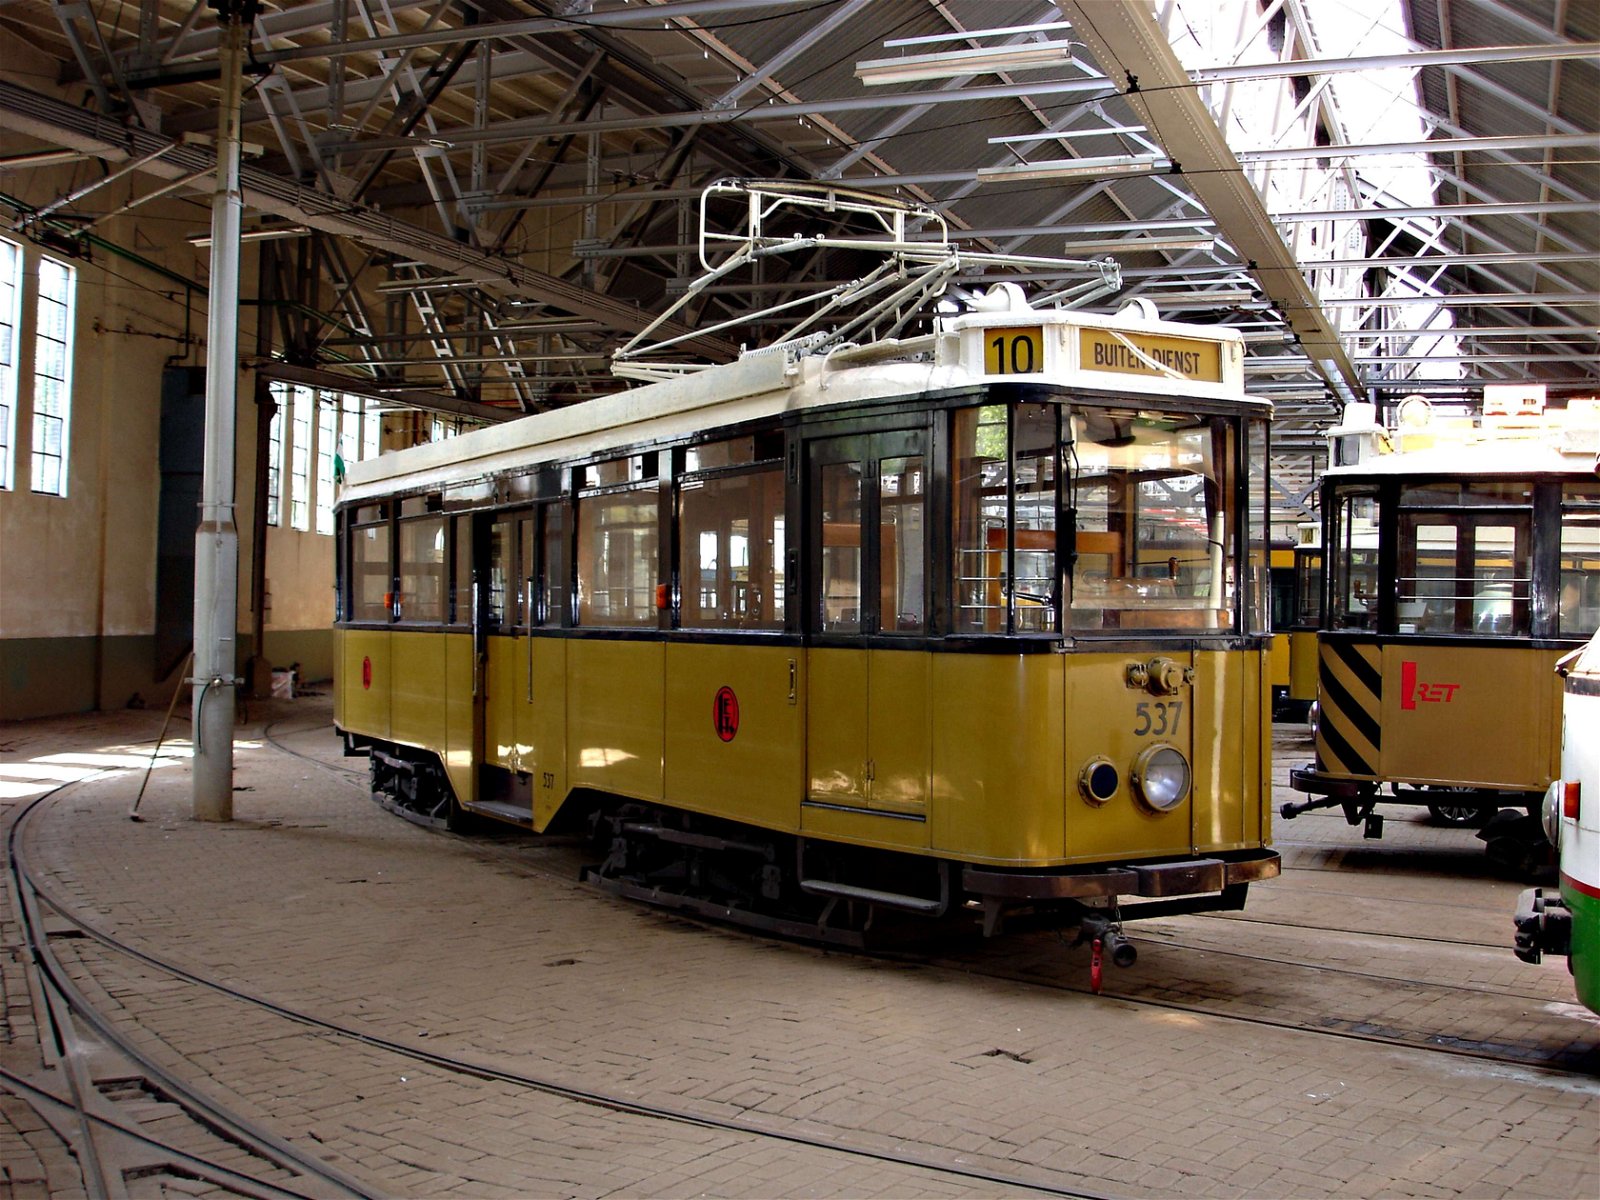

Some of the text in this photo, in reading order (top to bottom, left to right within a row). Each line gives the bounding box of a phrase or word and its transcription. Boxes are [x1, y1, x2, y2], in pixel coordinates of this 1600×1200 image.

[992, 334, 1034, 374] 10
[1417, 683, 1461, 703] RET
[1133, 701, 1183, 736] 537
